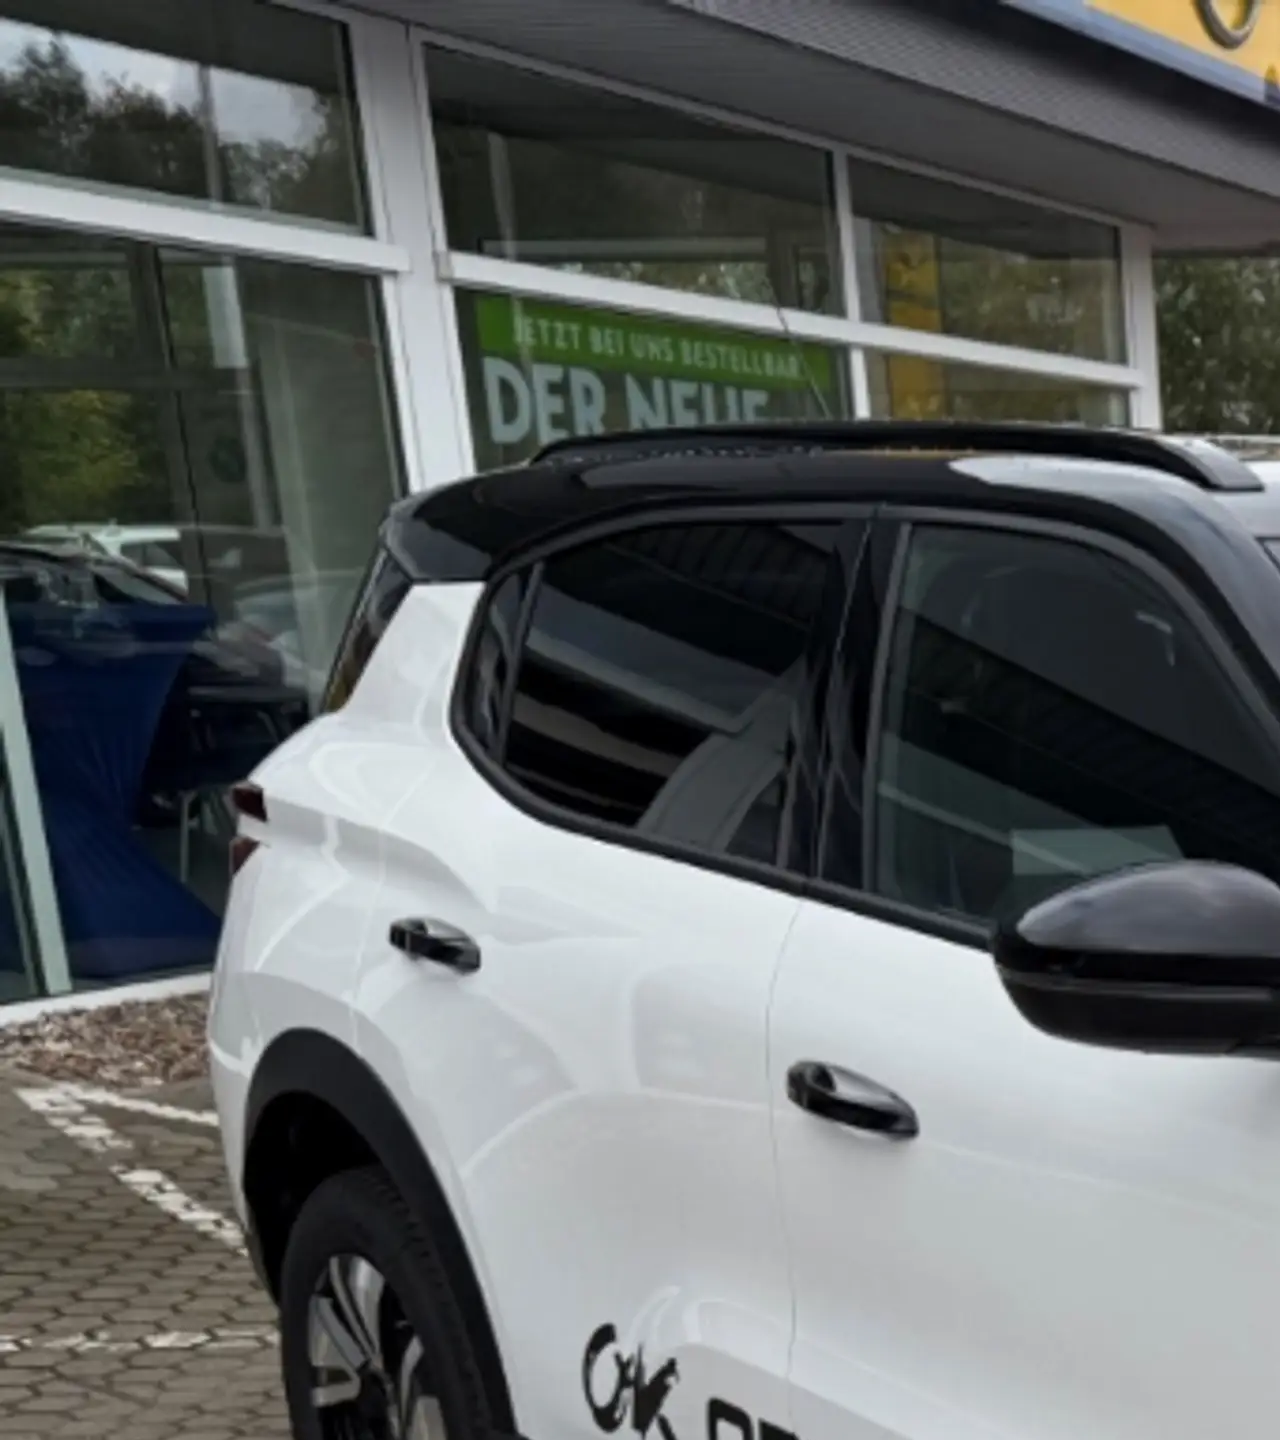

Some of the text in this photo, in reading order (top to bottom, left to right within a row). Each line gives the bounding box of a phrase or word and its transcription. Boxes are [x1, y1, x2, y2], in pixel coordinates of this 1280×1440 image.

[514, 315, 799, 379] JETZT BEI UNS BESTELLBAR
[482, 356, 606, 447] DER
